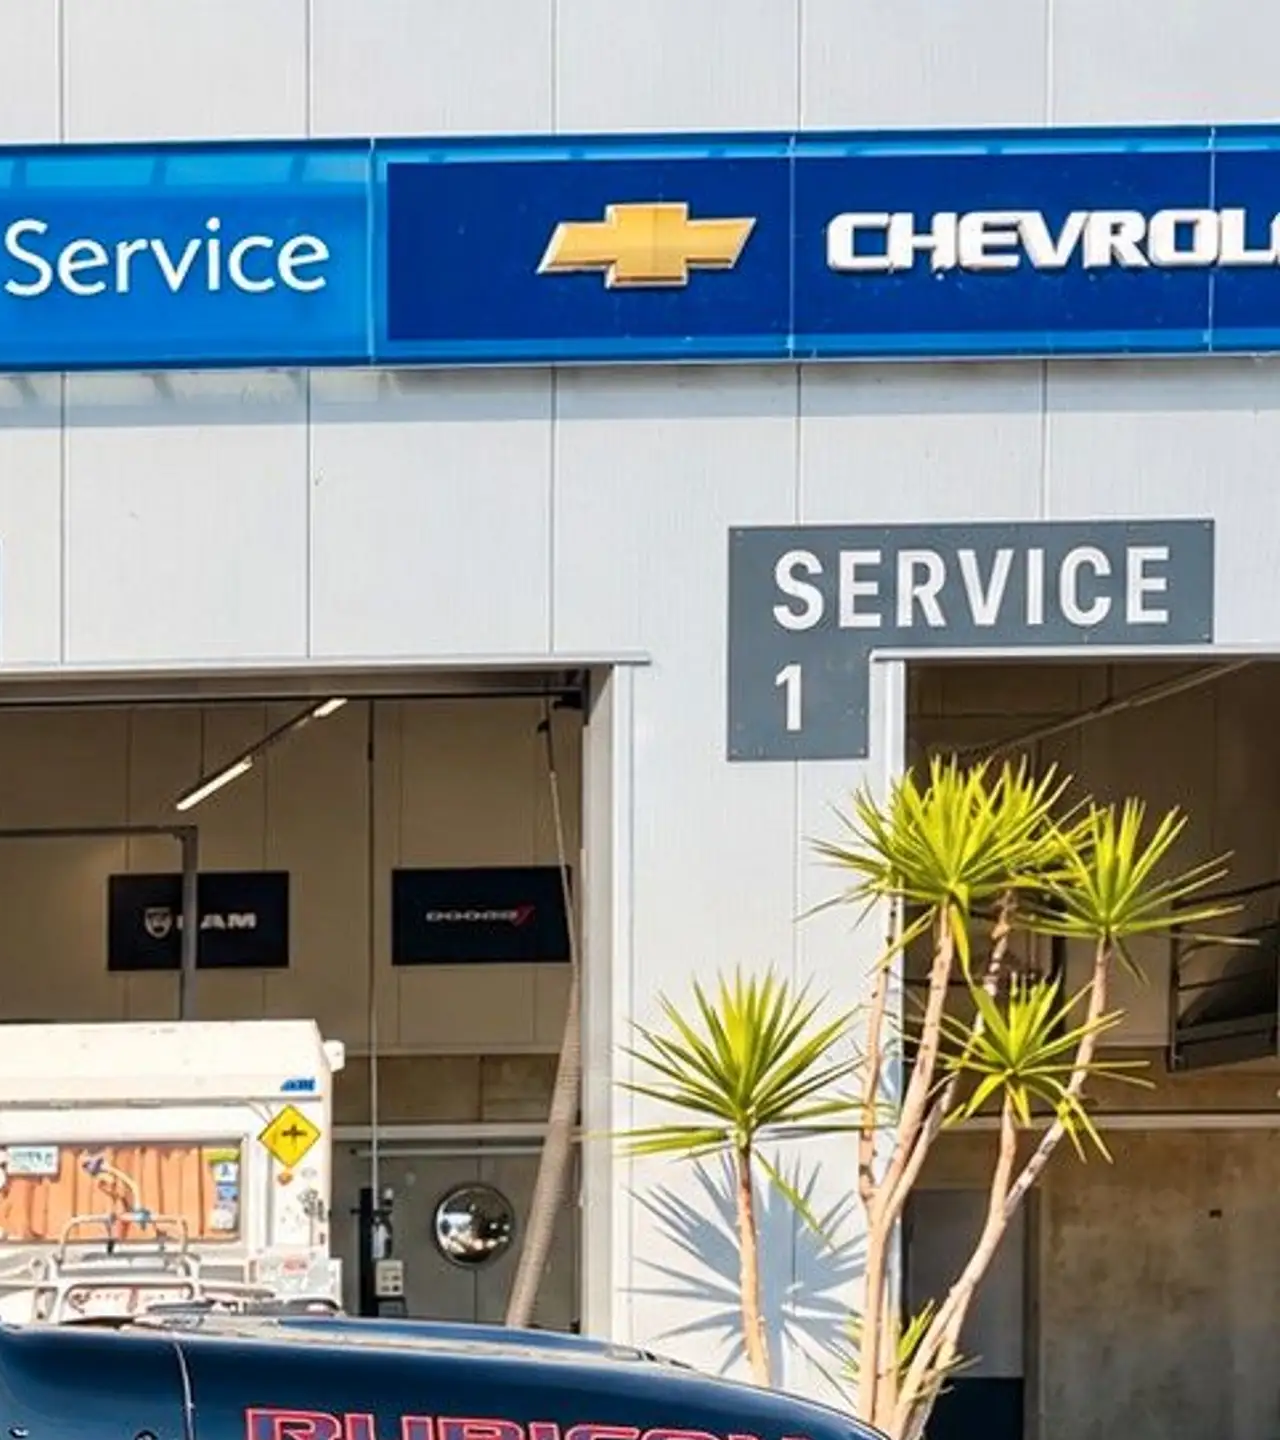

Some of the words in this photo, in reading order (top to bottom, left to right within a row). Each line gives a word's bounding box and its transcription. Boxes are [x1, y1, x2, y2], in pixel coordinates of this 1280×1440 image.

[3, 216, 329, 297] Service
[826, 208, 1280, 272] CHEVROL
[773, 545, 1171, 631] SERVICE
[774, 664, 802, 732] 1
